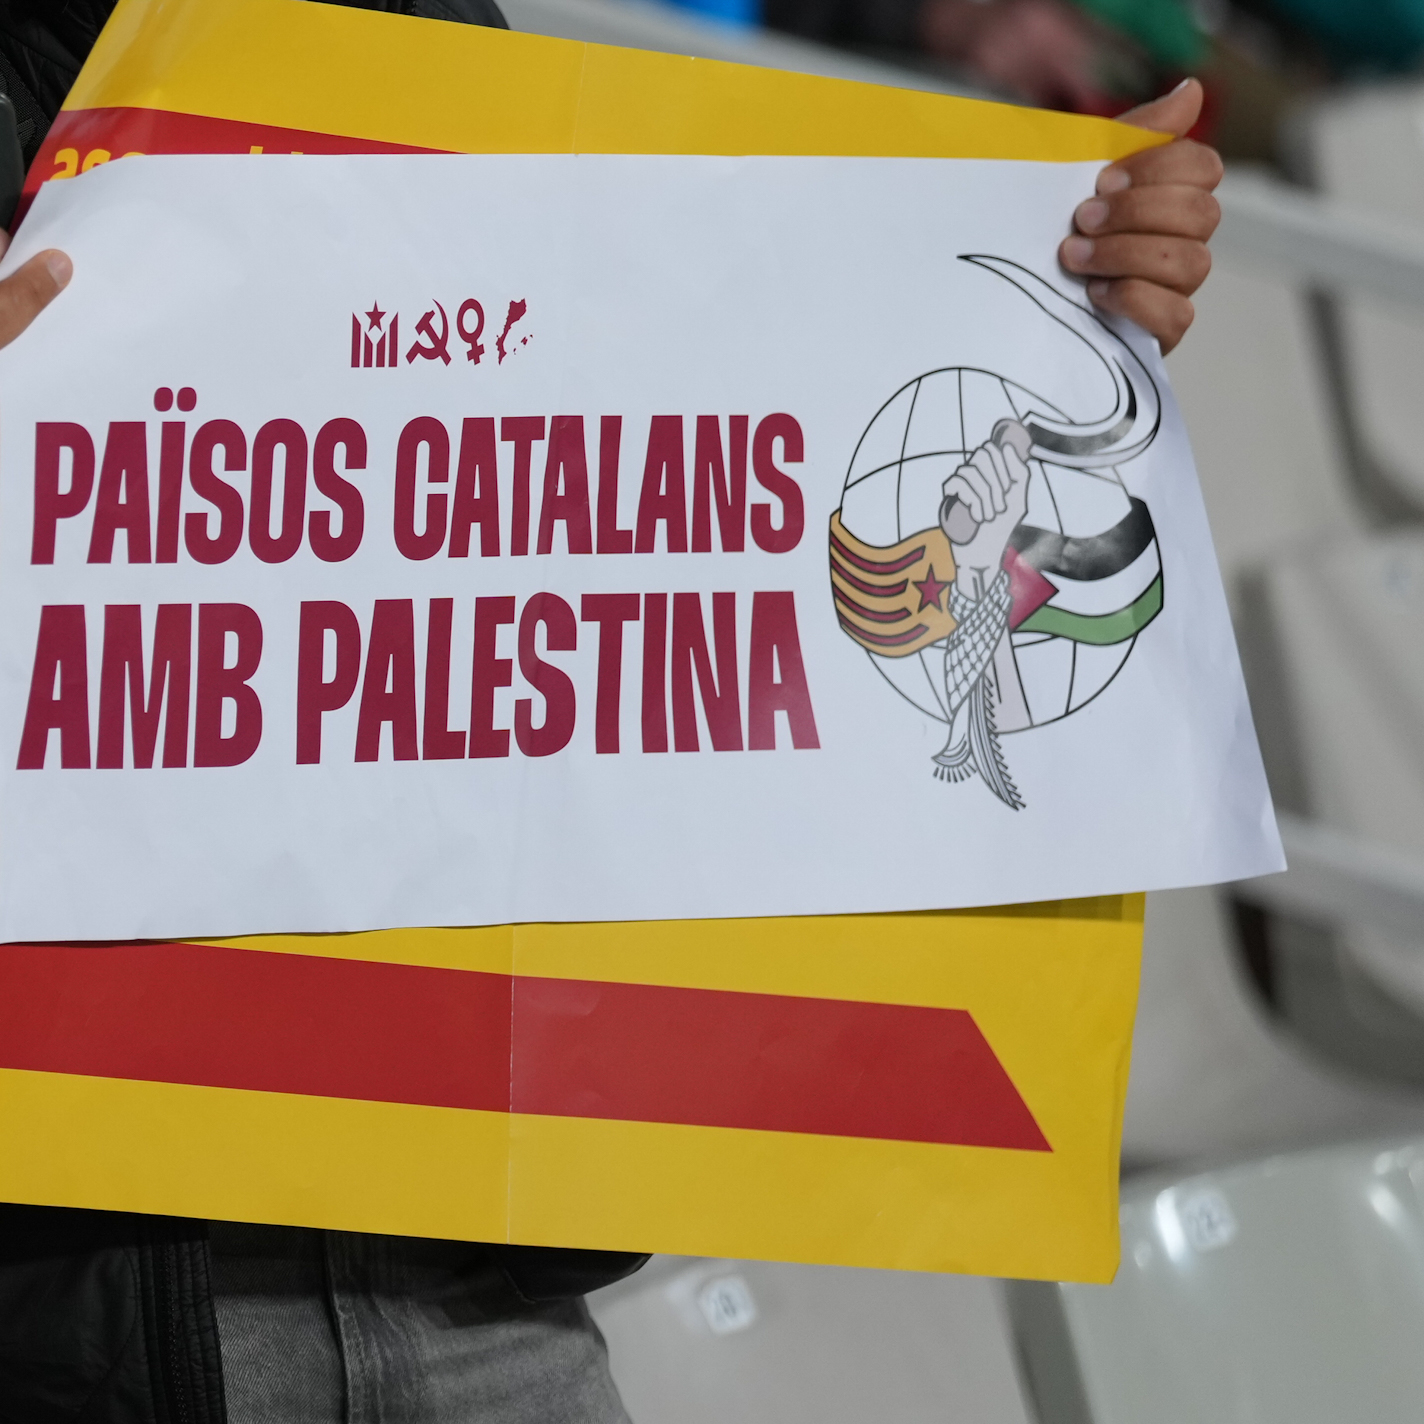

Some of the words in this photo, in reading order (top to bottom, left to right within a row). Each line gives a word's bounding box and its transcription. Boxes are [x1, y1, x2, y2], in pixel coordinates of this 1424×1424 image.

[30, 387, 368, 565] PAÏSOS
[392, 412, 806, 561] CATALANS
[16, 603, 265, 770] AMB
[295, 591, 821, 766] PALESTINA
